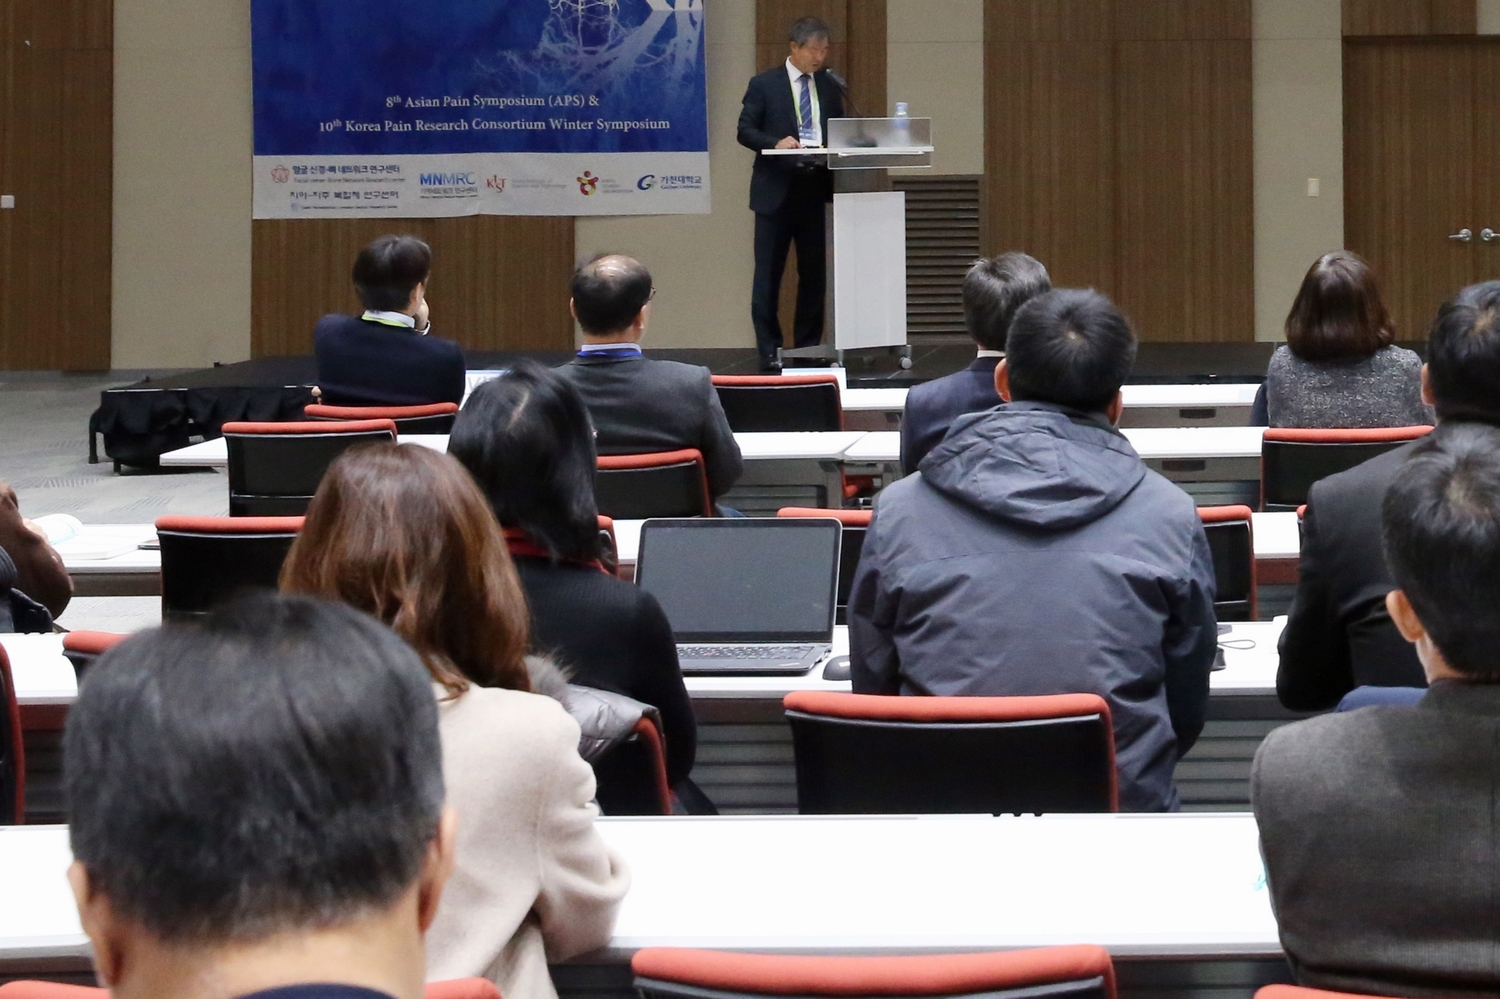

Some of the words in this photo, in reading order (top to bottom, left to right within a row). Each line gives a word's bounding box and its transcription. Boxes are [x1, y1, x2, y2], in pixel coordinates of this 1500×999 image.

[386, 95, 401, 108] 8th
[405, 97, 440, 108] Asian
[443, 96, 470, 107] Pain
[473, 95, 545, 109] Symposium
[549, 94, 585, 108] (APS)
[588, 96, 599, 106] &
[319, 119, 342, 132] 10th
[346, 121, 381, 132] Korea
[384, 120, 412, 132] Pain
[416, 119, 468, 131] Research
[472, 118, 546, 130] Consortium
[549, 118, 594, 130] Winter
[597, 118, 670, 132] Symposium
[420, 172, 476, 186] MNMRC
[660, 175, 702, 185] 가천대학교
